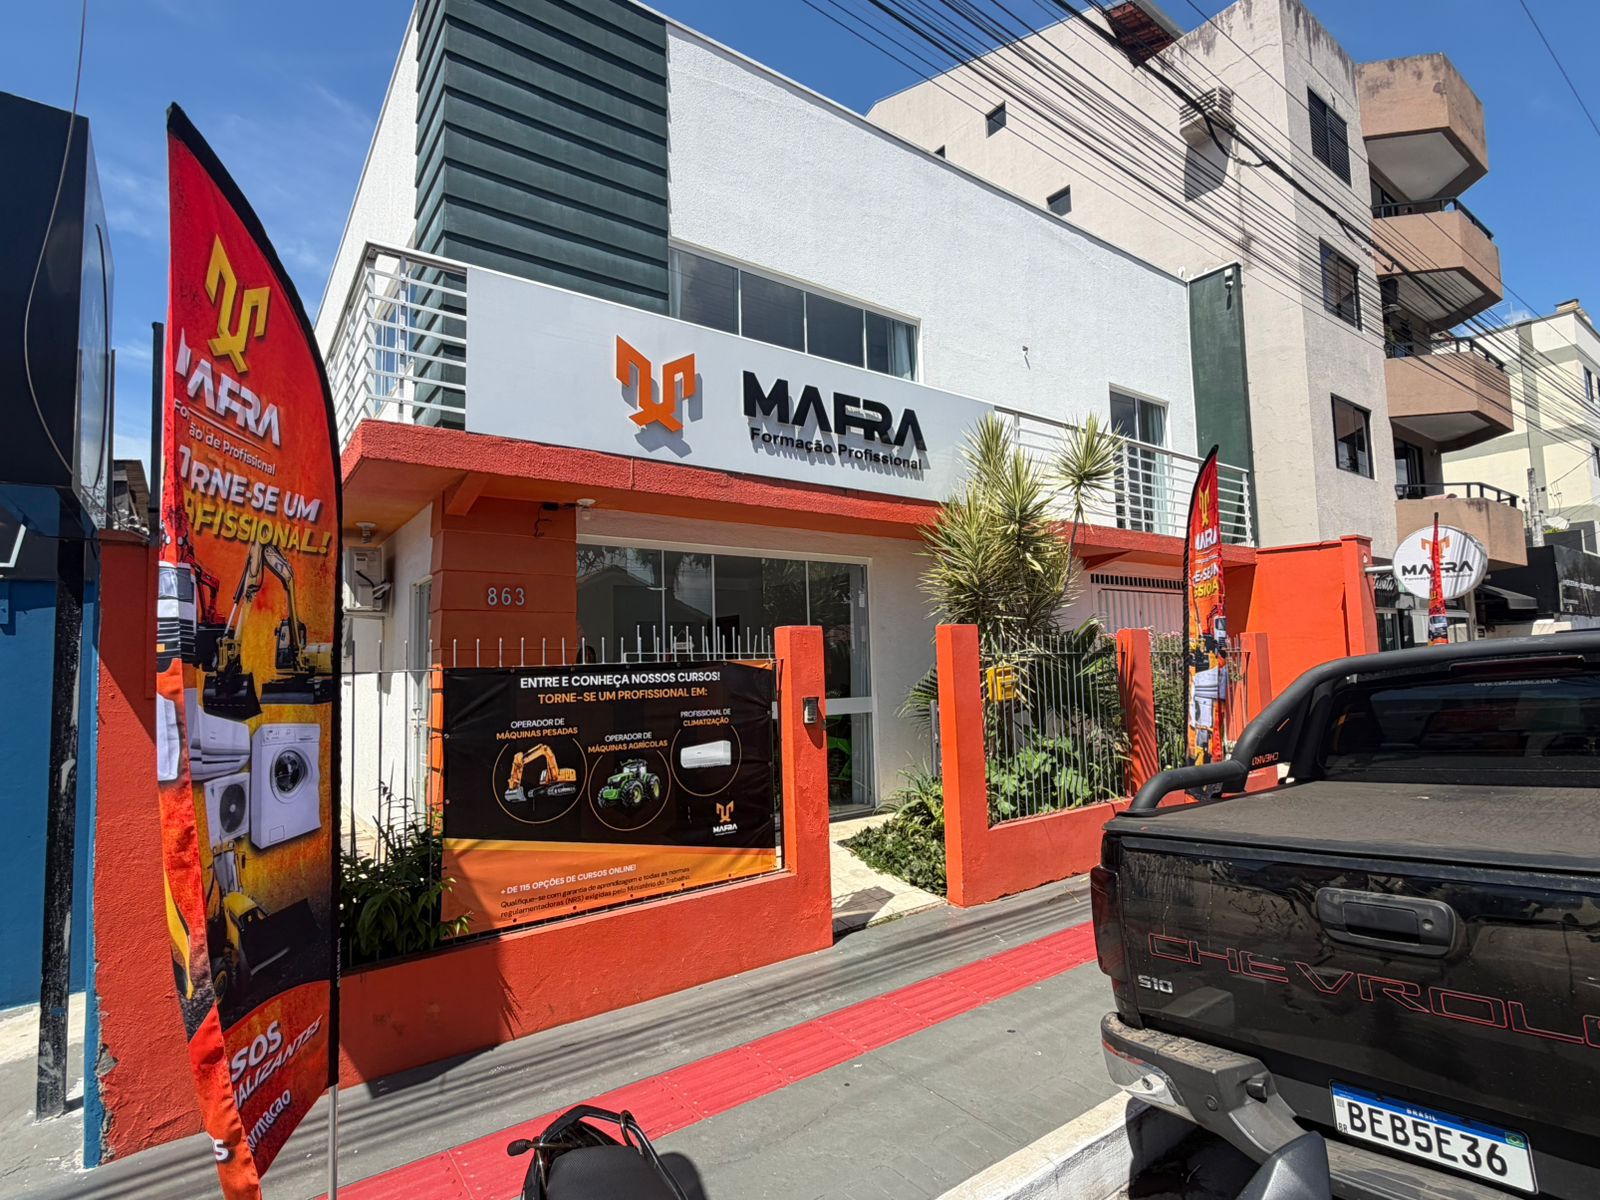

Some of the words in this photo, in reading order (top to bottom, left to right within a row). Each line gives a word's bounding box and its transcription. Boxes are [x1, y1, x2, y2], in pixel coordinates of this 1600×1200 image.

[743, 370, 927, 451] MAFRA
[205, 432, 220, 449] de
[223, 440, 276, 475] Profissional
[750, 427, 833, 454] Formação
[838, 443, 922, 470] Profissional
[283, 491, 321, 522] UM
[487, 587, 526, 607] 863
[520, 676, 560, 688] ENTRE
[562, 676, 569, 686] E
[571, 672, 629, 687] CONHEÇA
[631, 672, 676, 684] NOSSOS
[677, 671, 721, 682] CURSOS!
[538, 691, 596, 704] TORNE-SE
[598, 690, 616, 701] UM
[618, 688, 689, 700] PROFISSIONAL
[691, 686, 708, 697] EM:
[680, 709, 722, 718] PROFISSIONAL
[723, 708, 731, 716] DE
[682, 716, 730, 726] CLIMATIZAÇÃO
[510, 719, 553, 729] OPERADOR
[554, 717, 565, 726] DE
[496, 730, 542, 740] MÁQUINAS
[542, 727, 578, 737] PESADAS
[604, 733, 642, 742] OPERADOR
[643, 731, 652, 739] DE
[588, 743, 628, 753] MÁQUINAS
[628, 740, 668, 750] AGRÍCOLAS
[507, 885, 518, 894] DE
[519, 883, 531, 892] 115
[532, 877, 565, 889] OPÇÕES
[565, 874, 576, 883] DE
[577, 869, 607, 881] CURSOS
[546, 892, 562, 900] com
[1137, 974, 1174, 994] S10
[1406, 1107, 1438, 1122] BRASIL
[1347, 1101, 1508, 1177] BEB5E36
